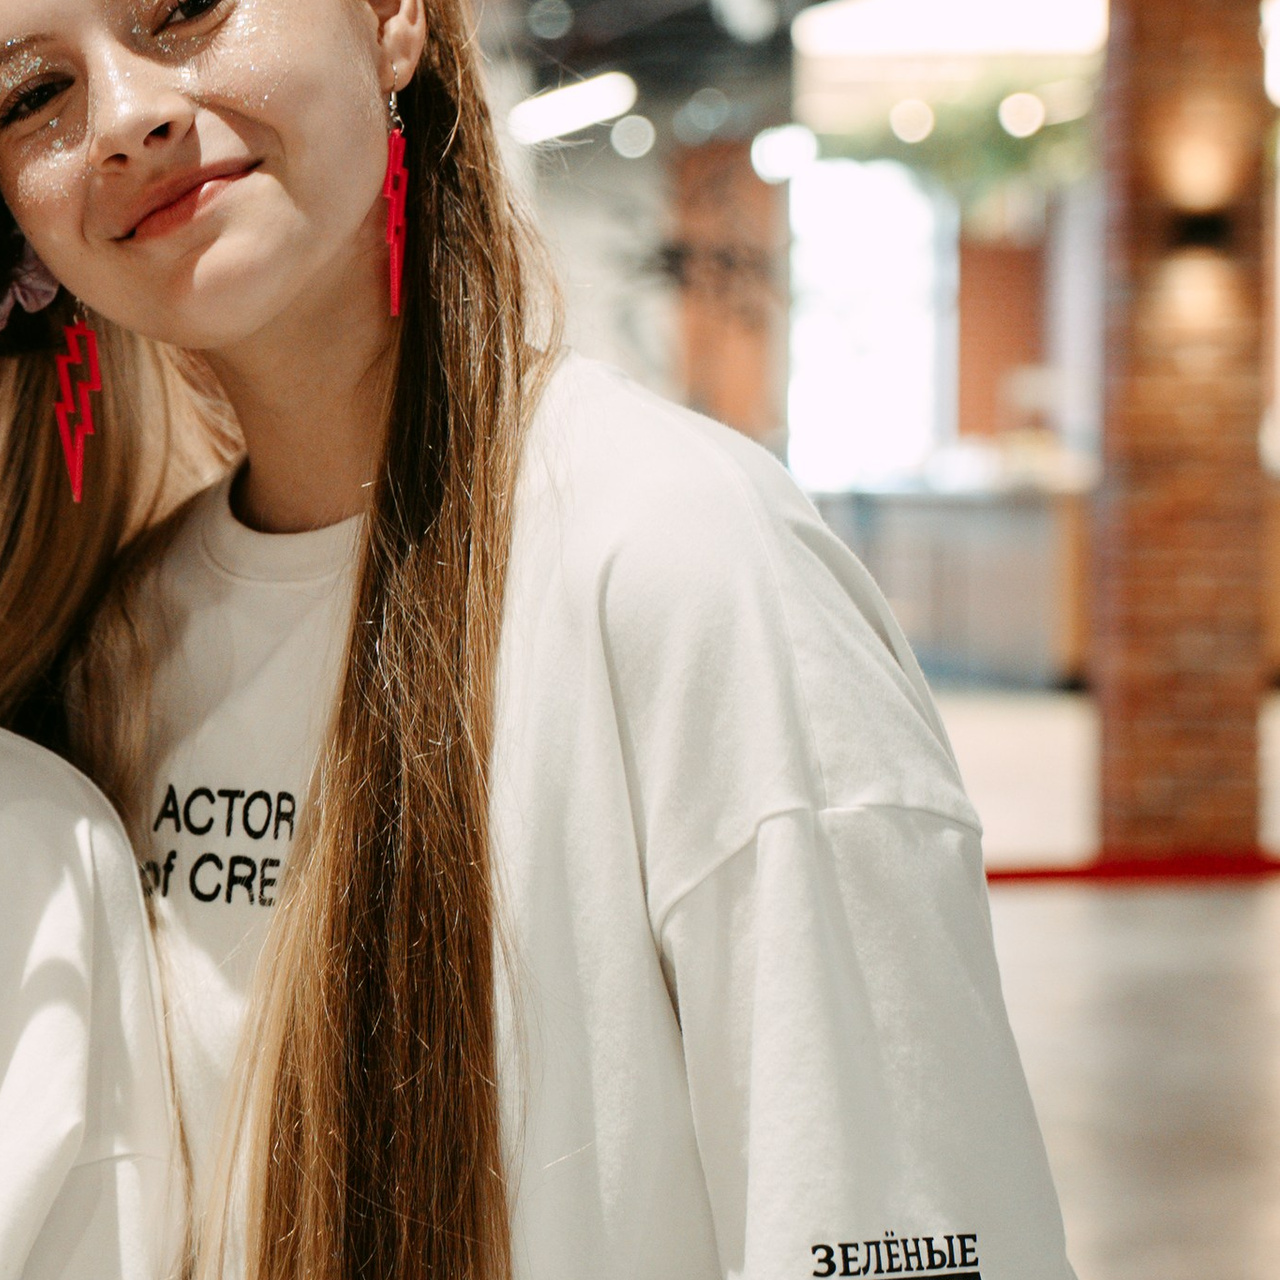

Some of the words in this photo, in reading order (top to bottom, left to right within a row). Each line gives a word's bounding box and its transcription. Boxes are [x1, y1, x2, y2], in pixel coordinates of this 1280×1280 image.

[153, 783, 296, 840] ACTOR
[189, 853, 281, 907] CRE
[811, 1230, 979, 1278] ЗЕЛЁНЫЕ
